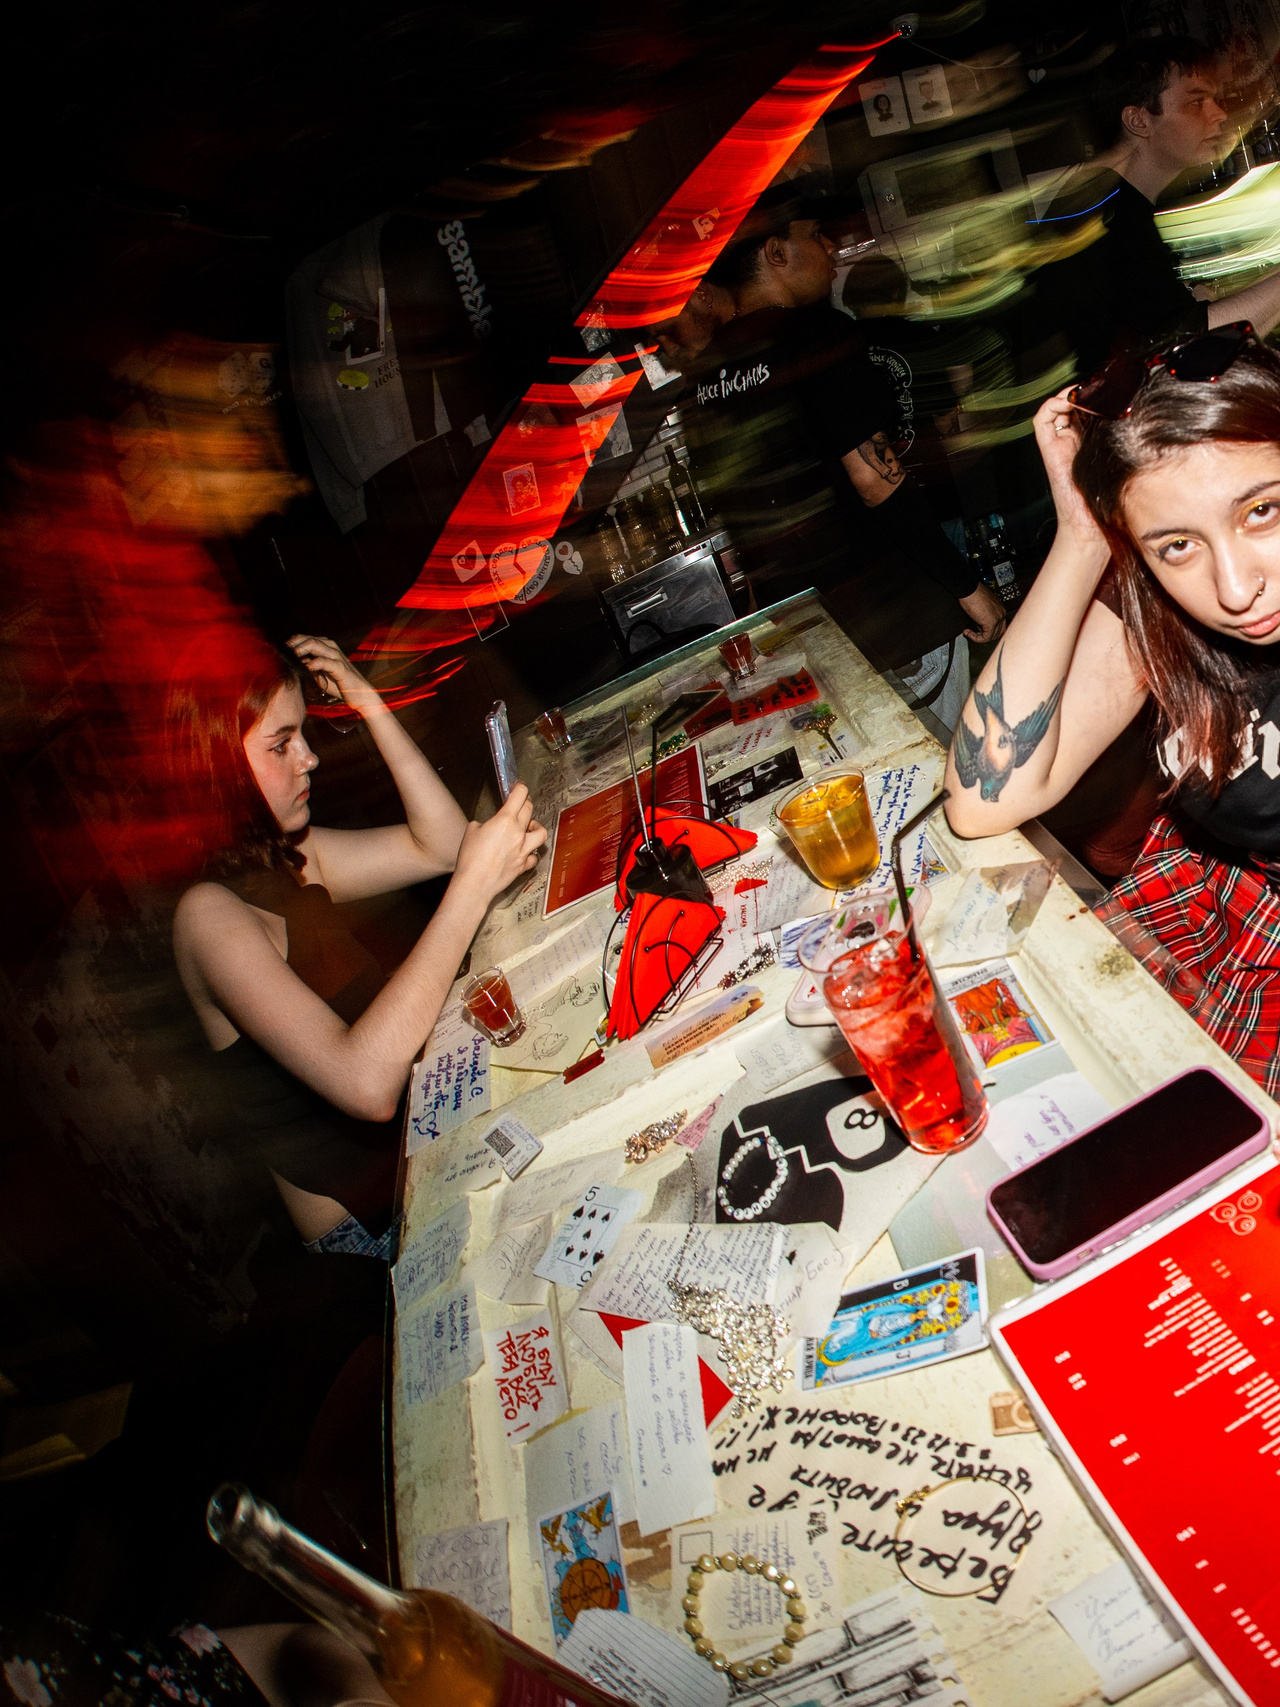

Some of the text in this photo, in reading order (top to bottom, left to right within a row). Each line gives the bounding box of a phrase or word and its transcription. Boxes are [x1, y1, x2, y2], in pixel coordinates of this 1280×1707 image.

[585, 1186, 600, 1201] 5
[496, 1331, 515, 1375] ТЕБЯ
[531, 1326, 558, 1388] Я БУДУ
[789, 1464, 900, 1512] любите
